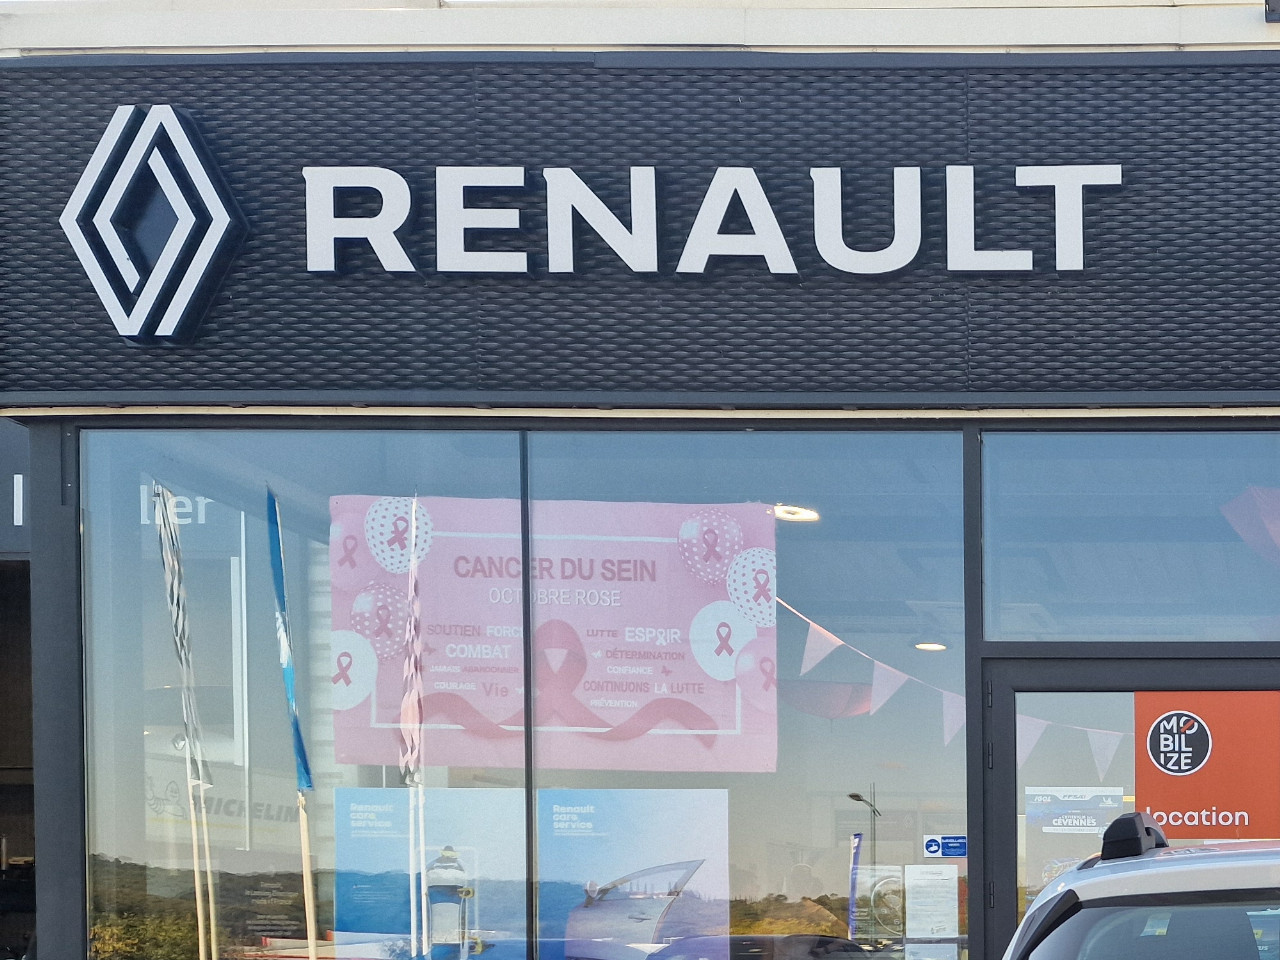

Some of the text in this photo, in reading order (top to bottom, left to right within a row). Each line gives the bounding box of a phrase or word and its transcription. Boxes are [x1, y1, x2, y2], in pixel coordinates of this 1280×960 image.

[302, 164, 1122, 273] RENAULT
[453, 555, 657, 582] CANCER DU SEIN
[489, 587, 621, 606] OCTBRE ROSE
[427, 624, 523, 638] SOUTIEN FORC
[445, 644, 511, 659] COMBAT
[481, 682, 509, 697] Vie
[654, 683, 668, 694] LA
[671, 683, 704, 694] LUTTE
[553, 804, 595, 813] Renault
[553, 820, 593, 829] service
